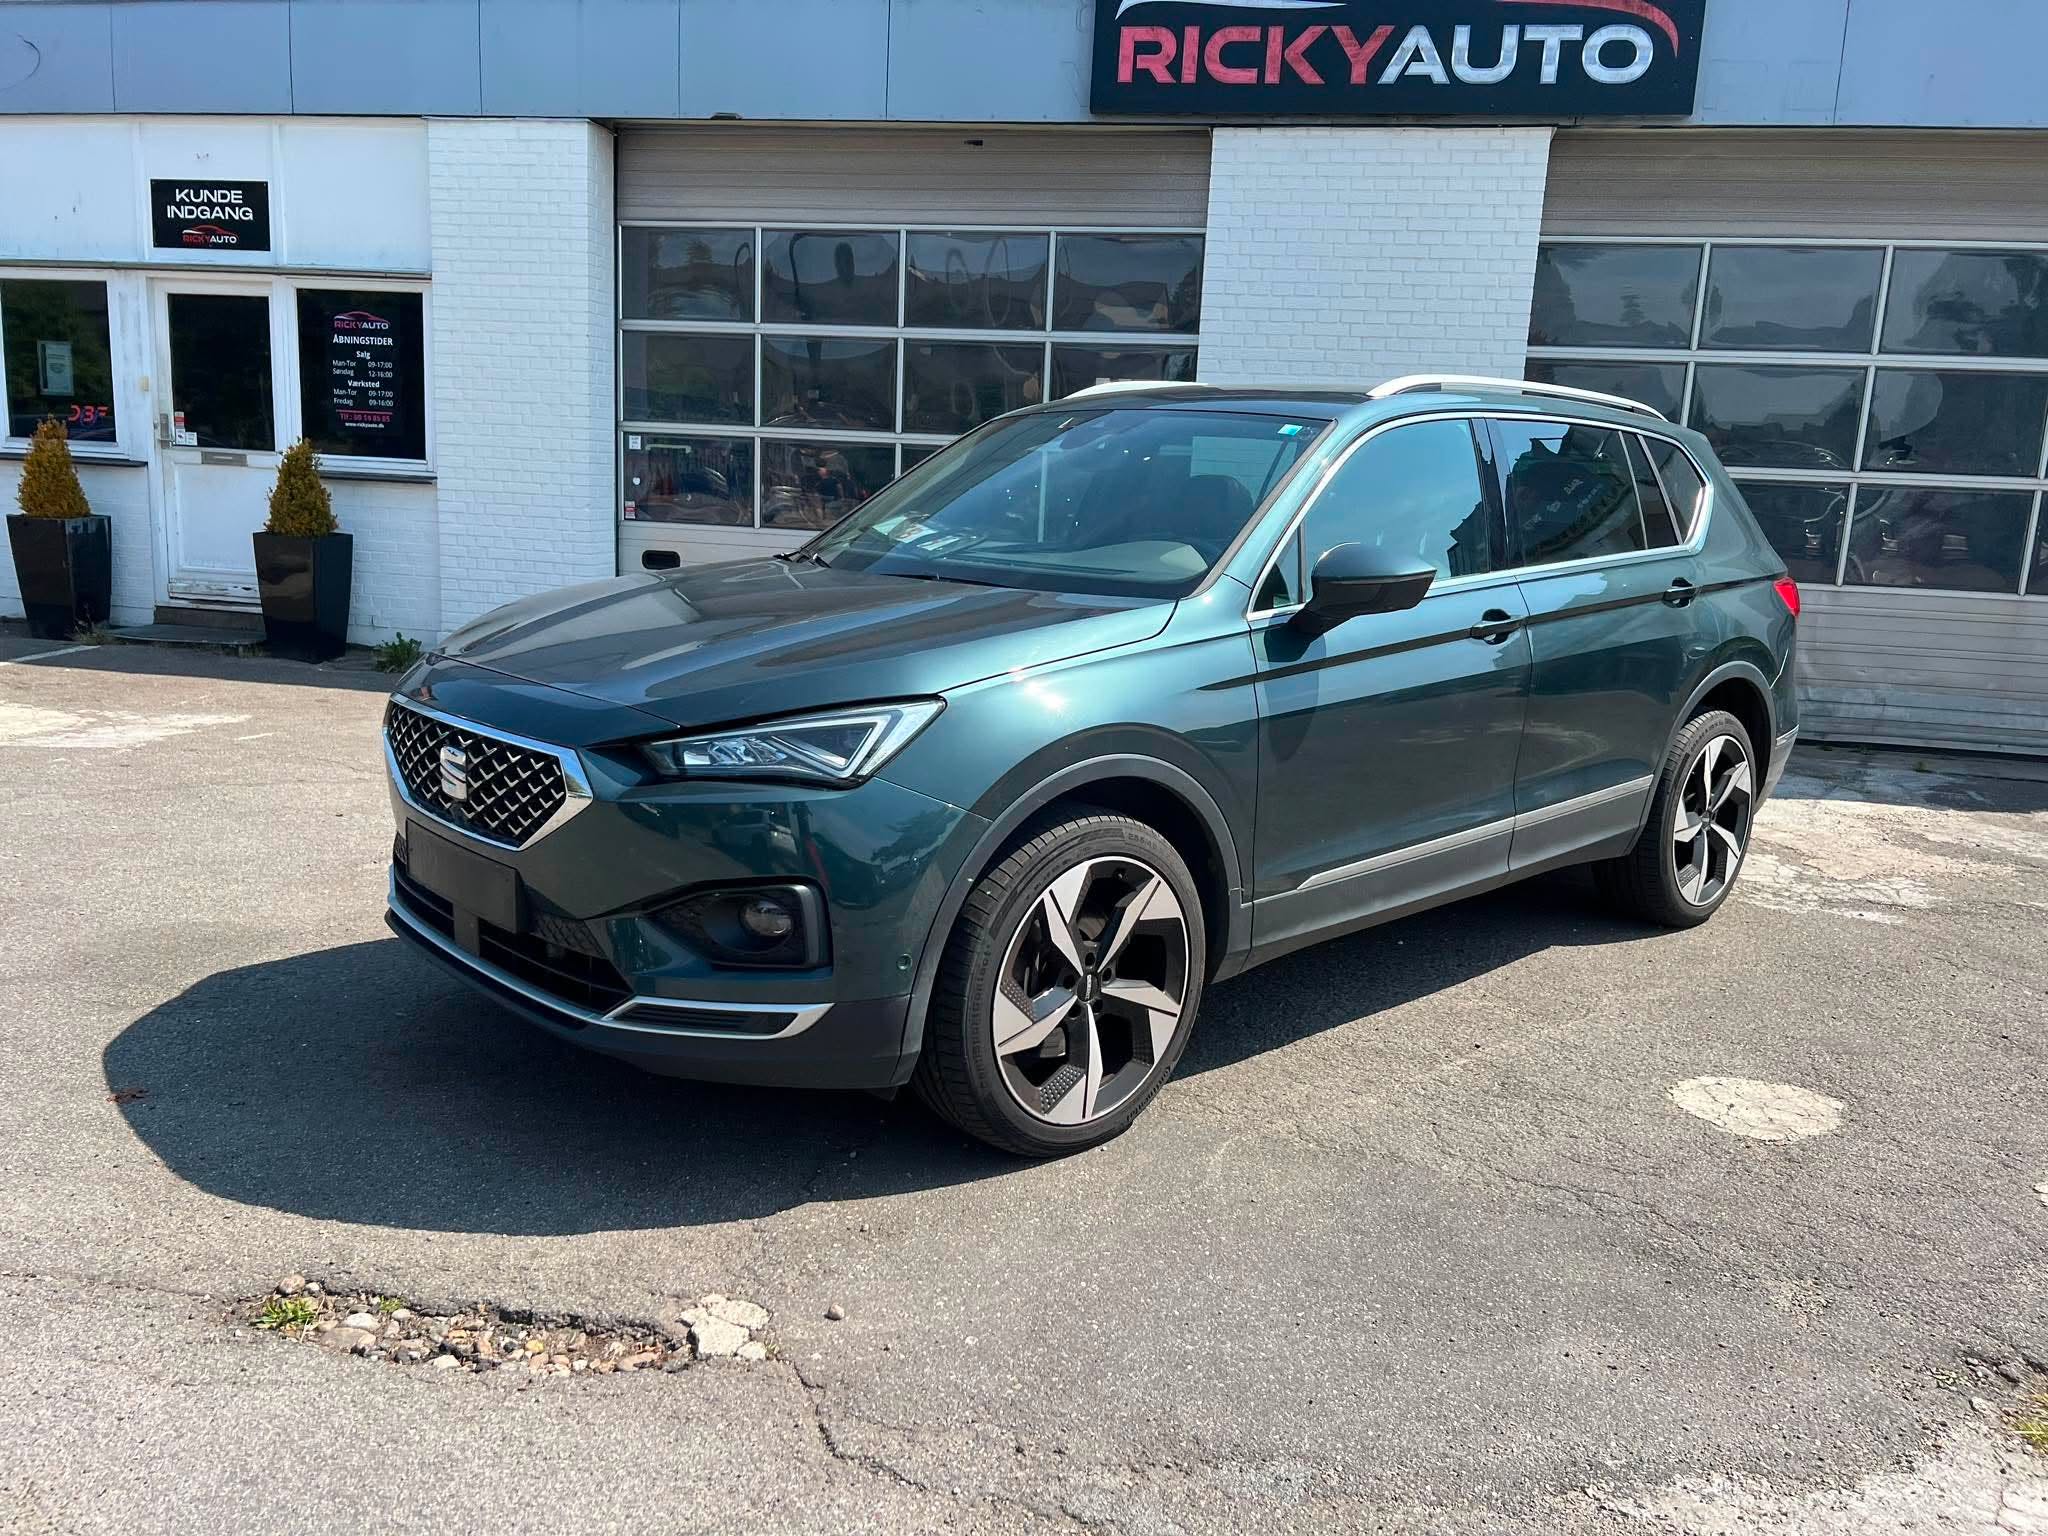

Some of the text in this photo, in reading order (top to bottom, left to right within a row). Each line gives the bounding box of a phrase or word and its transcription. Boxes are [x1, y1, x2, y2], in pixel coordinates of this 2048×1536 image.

[1117, 23, 1654, 85] RICKYAUTO
[175, 188, 243, 204] KUNDE
[167, 205, 254, 221] INDGANG
[182, 234, 238, 244] RICKYAUTO
[334, 320, 389, 330] RICKYAUTO
[332, 333, 394, 346] ÅBNINGSTIDER
[356, 350, 371, 360] Salg
[347, 379, 380, 388] Værksted
[333, 388, 358, 396] Man-Tor
[333, 398, 354, 407] Fredag
